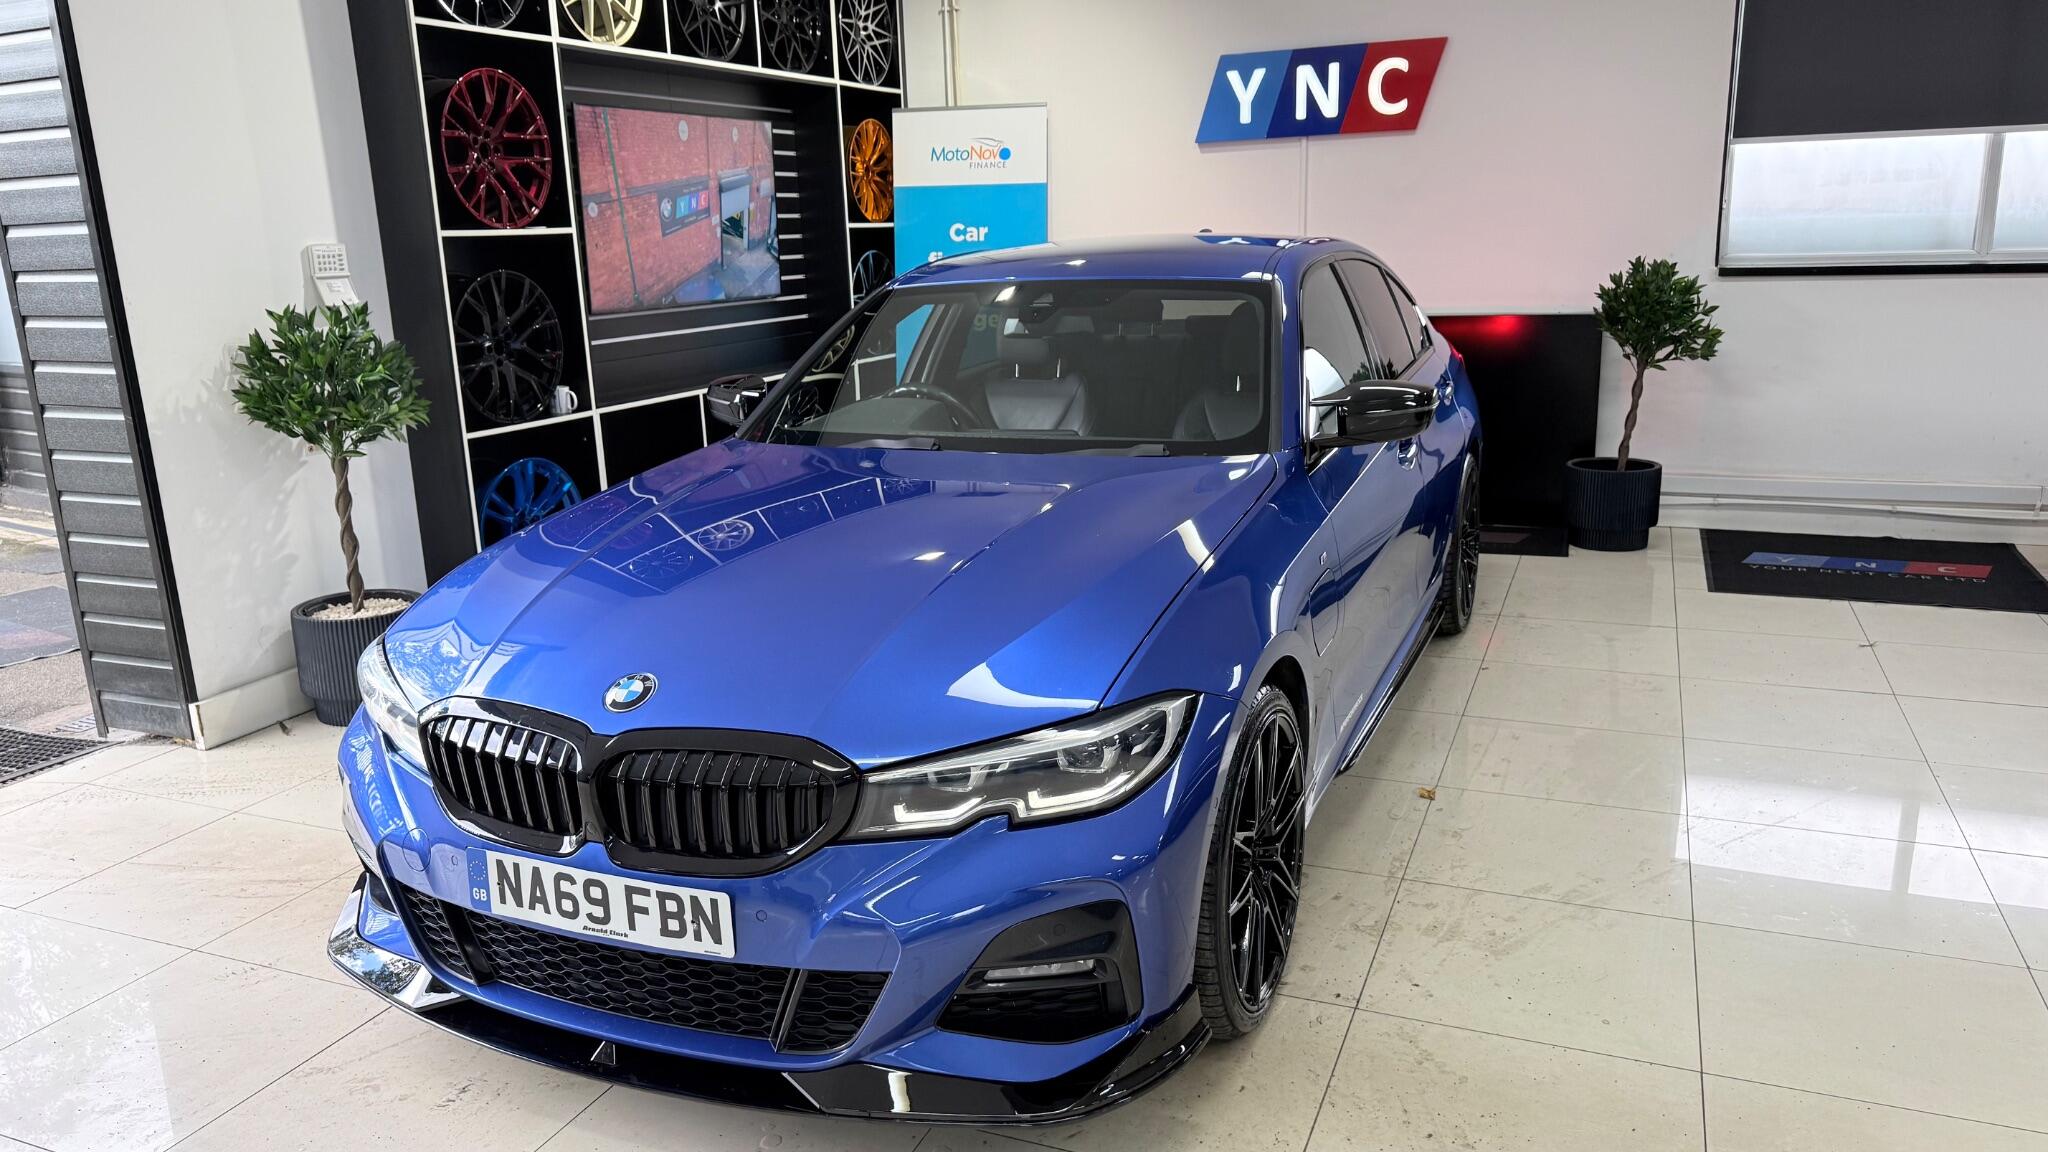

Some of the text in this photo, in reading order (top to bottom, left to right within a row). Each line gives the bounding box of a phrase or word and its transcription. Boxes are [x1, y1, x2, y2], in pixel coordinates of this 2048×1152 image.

[1226, 57, 1409, 124] YNC
[969, 161, 1008, 169] FINANCE
[949, 223, 988, 242] Car
[472, 888, 487, 901] GB
[495, 858, 722, 945] NA69 FBN
[582, 925, 629, 939] Arnold Clark
